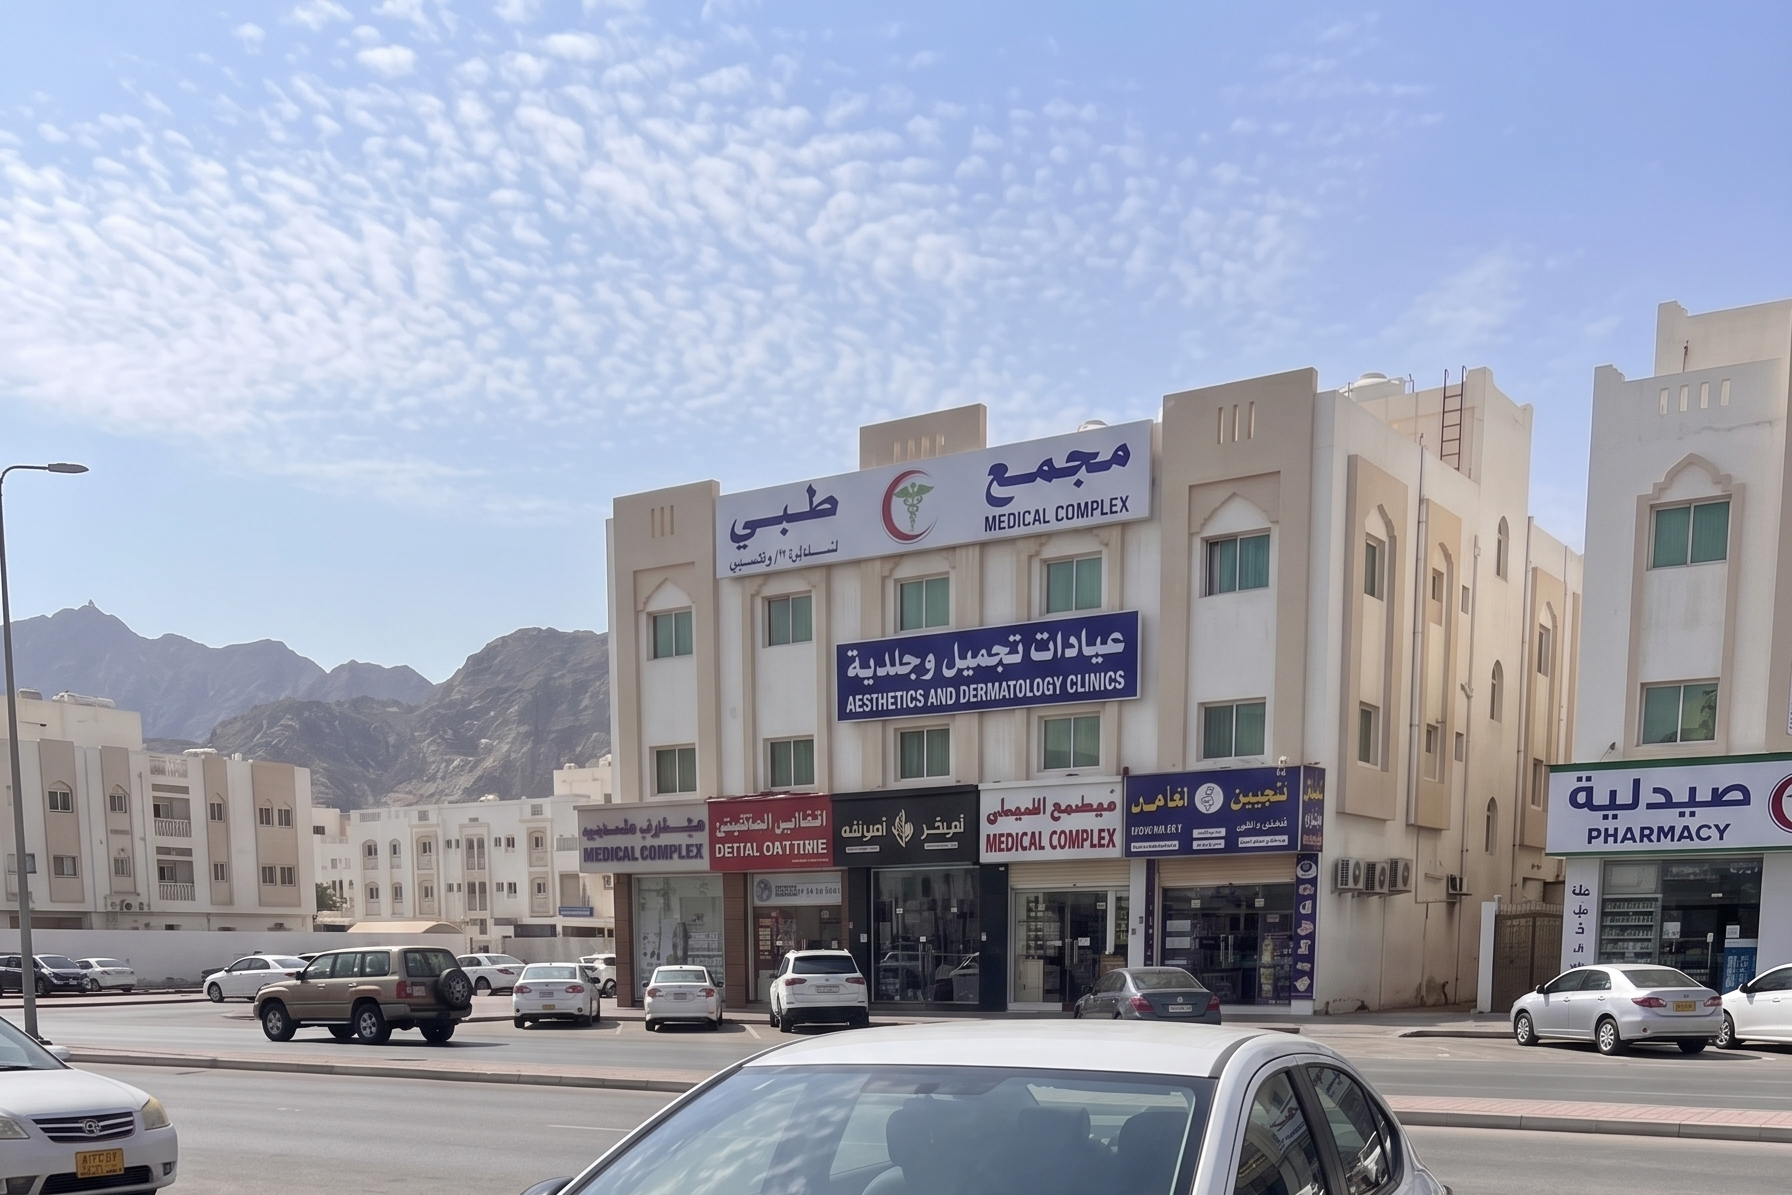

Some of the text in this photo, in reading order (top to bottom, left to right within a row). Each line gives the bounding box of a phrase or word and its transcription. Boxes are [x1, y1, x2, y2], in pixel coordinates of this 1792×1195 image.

[729, 442, 1131, 550] مجمع طبي
[984, 495, 1130, 533] MEDICAL COMPLEX
[846, 628, 1126, 686] عيادات تجميل وجلدية
[846, 670, 1126, 713] AESTHETICS AND DERMATOLOGY CLINICS
[1568, 775, 1752, 821] صيدلية
[583, 843, 704, 863] MEDICAL COMPLEX
[985, 830, 1046, 853] MEDICAL
[1048, 827, 1117, 850] COMPLEX
[1587, 823, 1731, 845] PHARMACY
